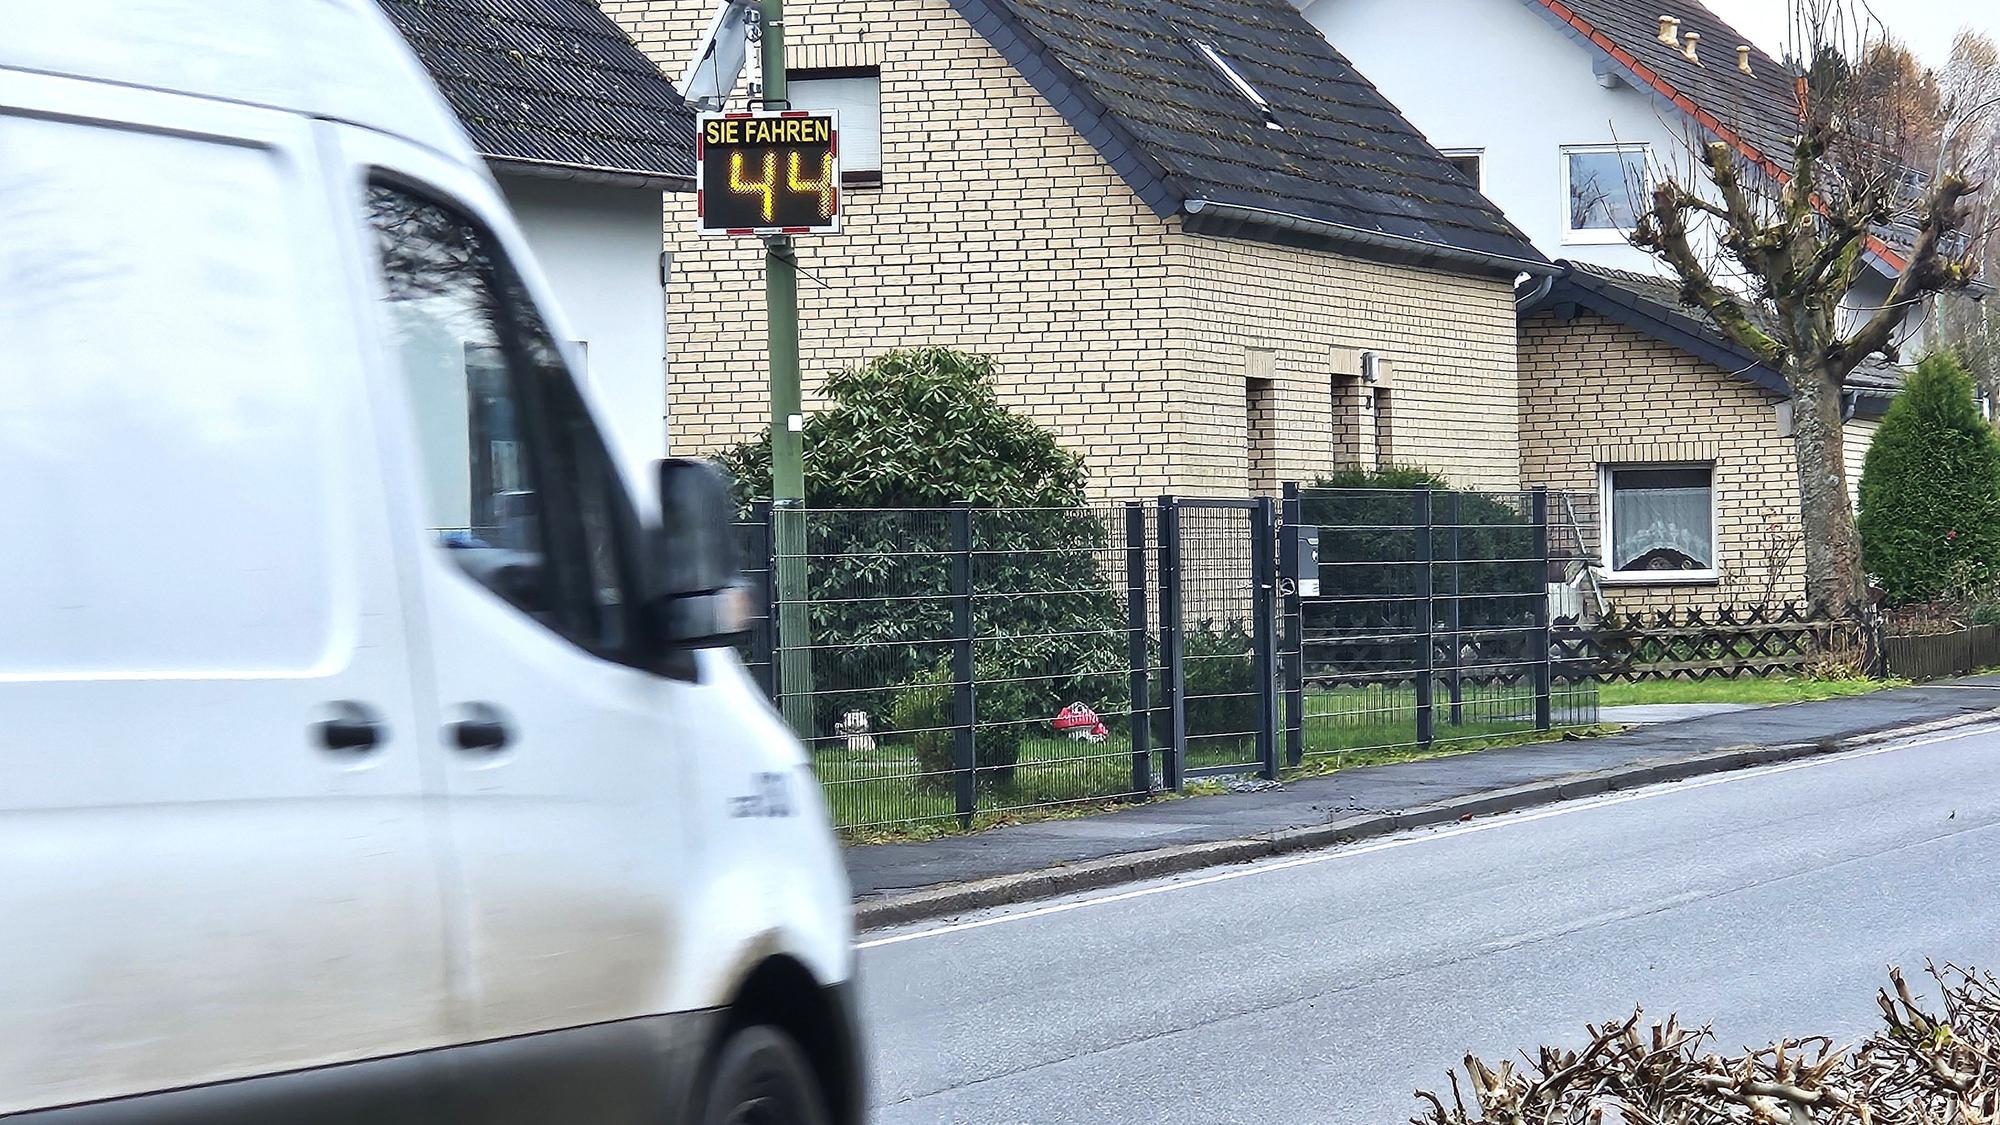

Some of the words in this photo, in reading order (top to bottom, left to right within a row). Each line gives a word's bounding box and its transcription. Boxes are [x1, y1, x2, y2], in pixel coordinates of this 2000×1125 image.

[706, 121, 739, 144] SIE
[745, 119, 829, 143] FAHREN
[728, 150, 833, 222] 44
